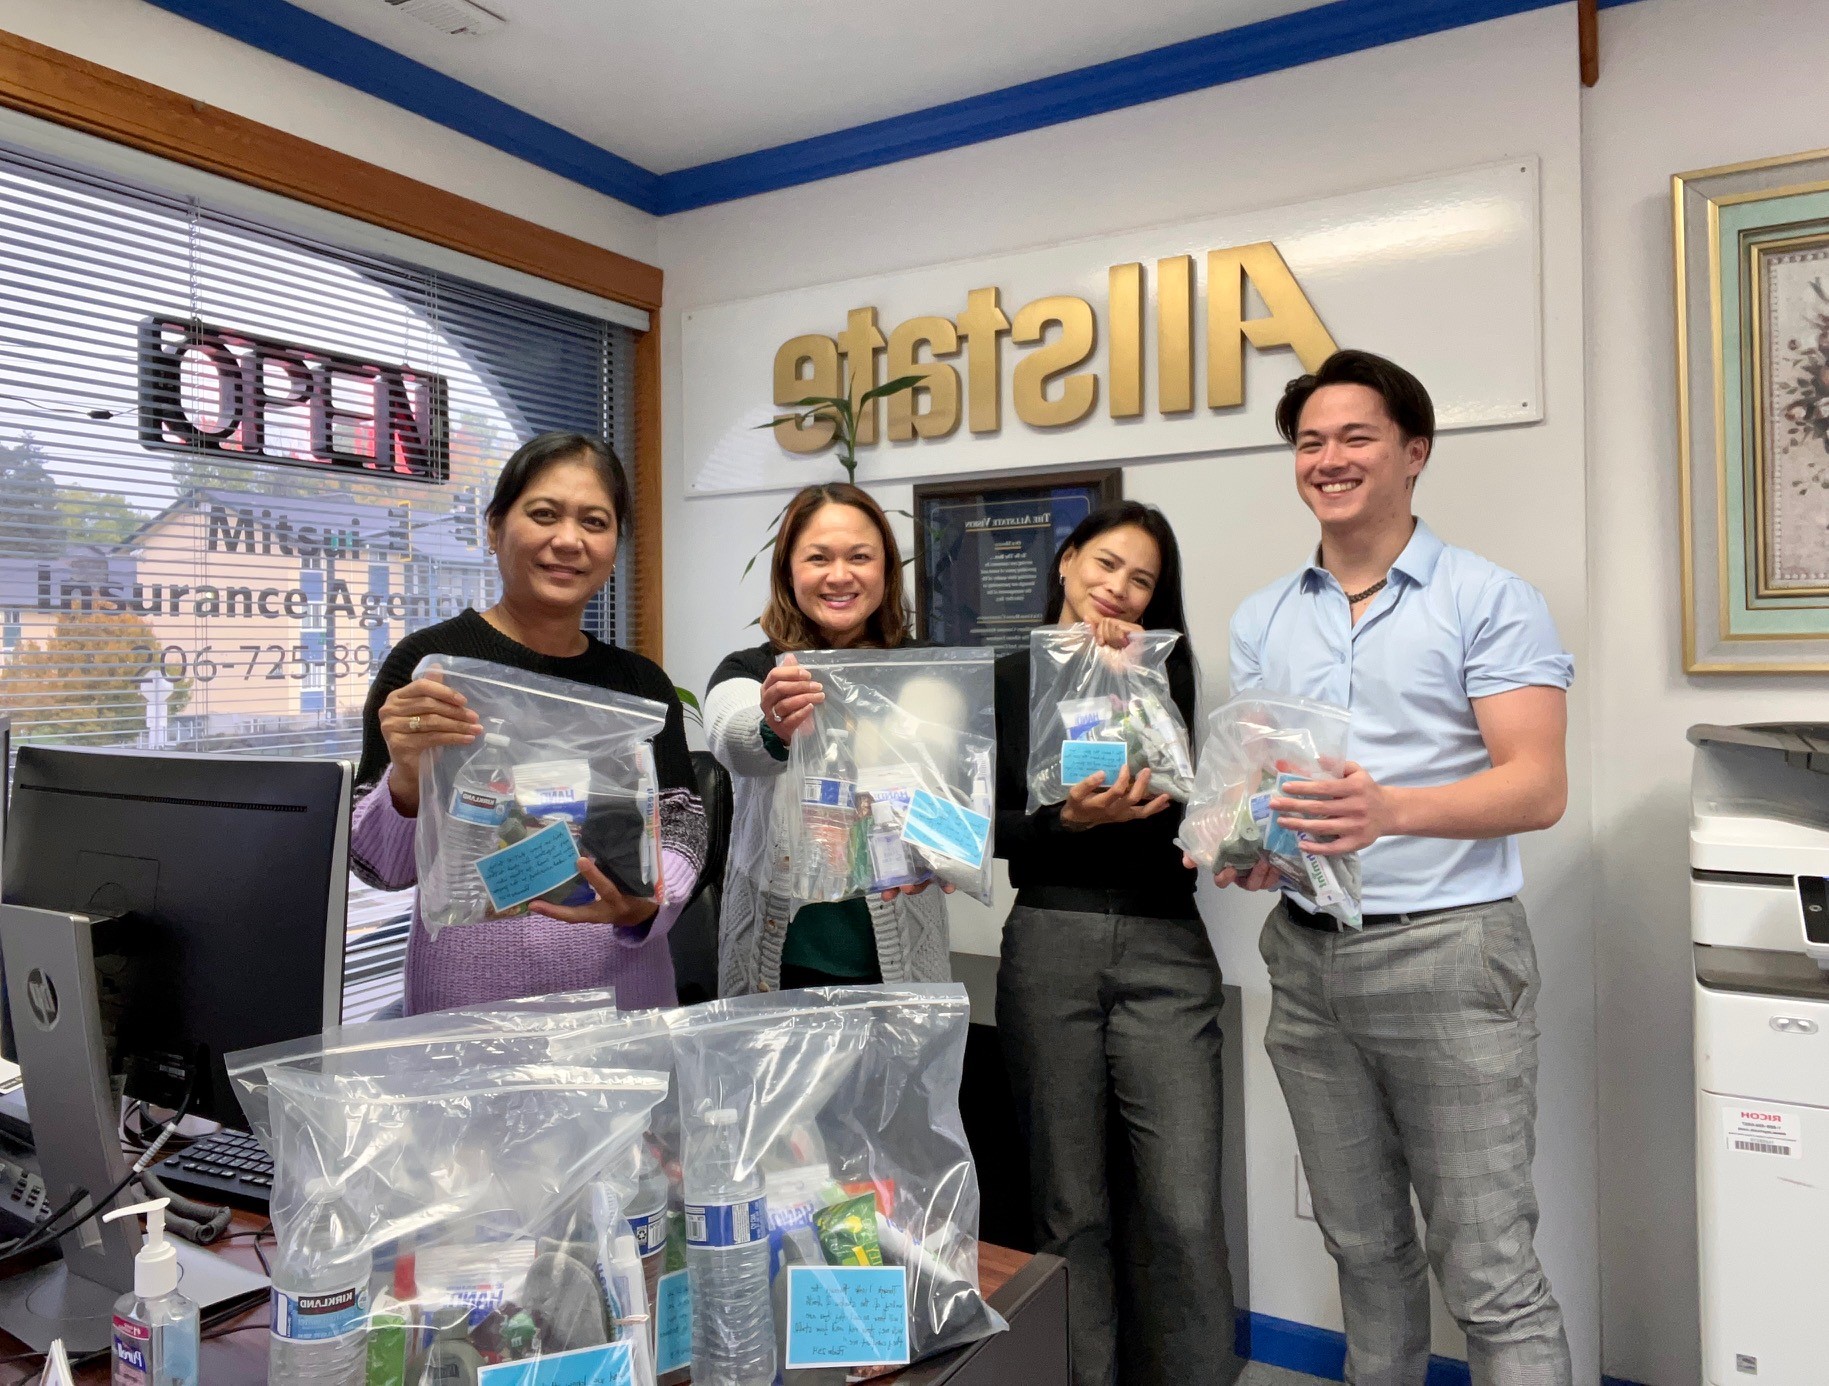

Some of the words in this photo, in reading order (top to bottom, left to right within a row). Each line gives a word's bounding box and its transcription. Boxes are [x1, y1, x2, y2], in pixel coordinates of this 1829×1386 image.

[161, 330, 430, 474] OPEN
[208, 505, 360, 559] Mitsui
[37, 564, 308, 619] Insurance
[130, 644, 393, 684] 206-725-89
